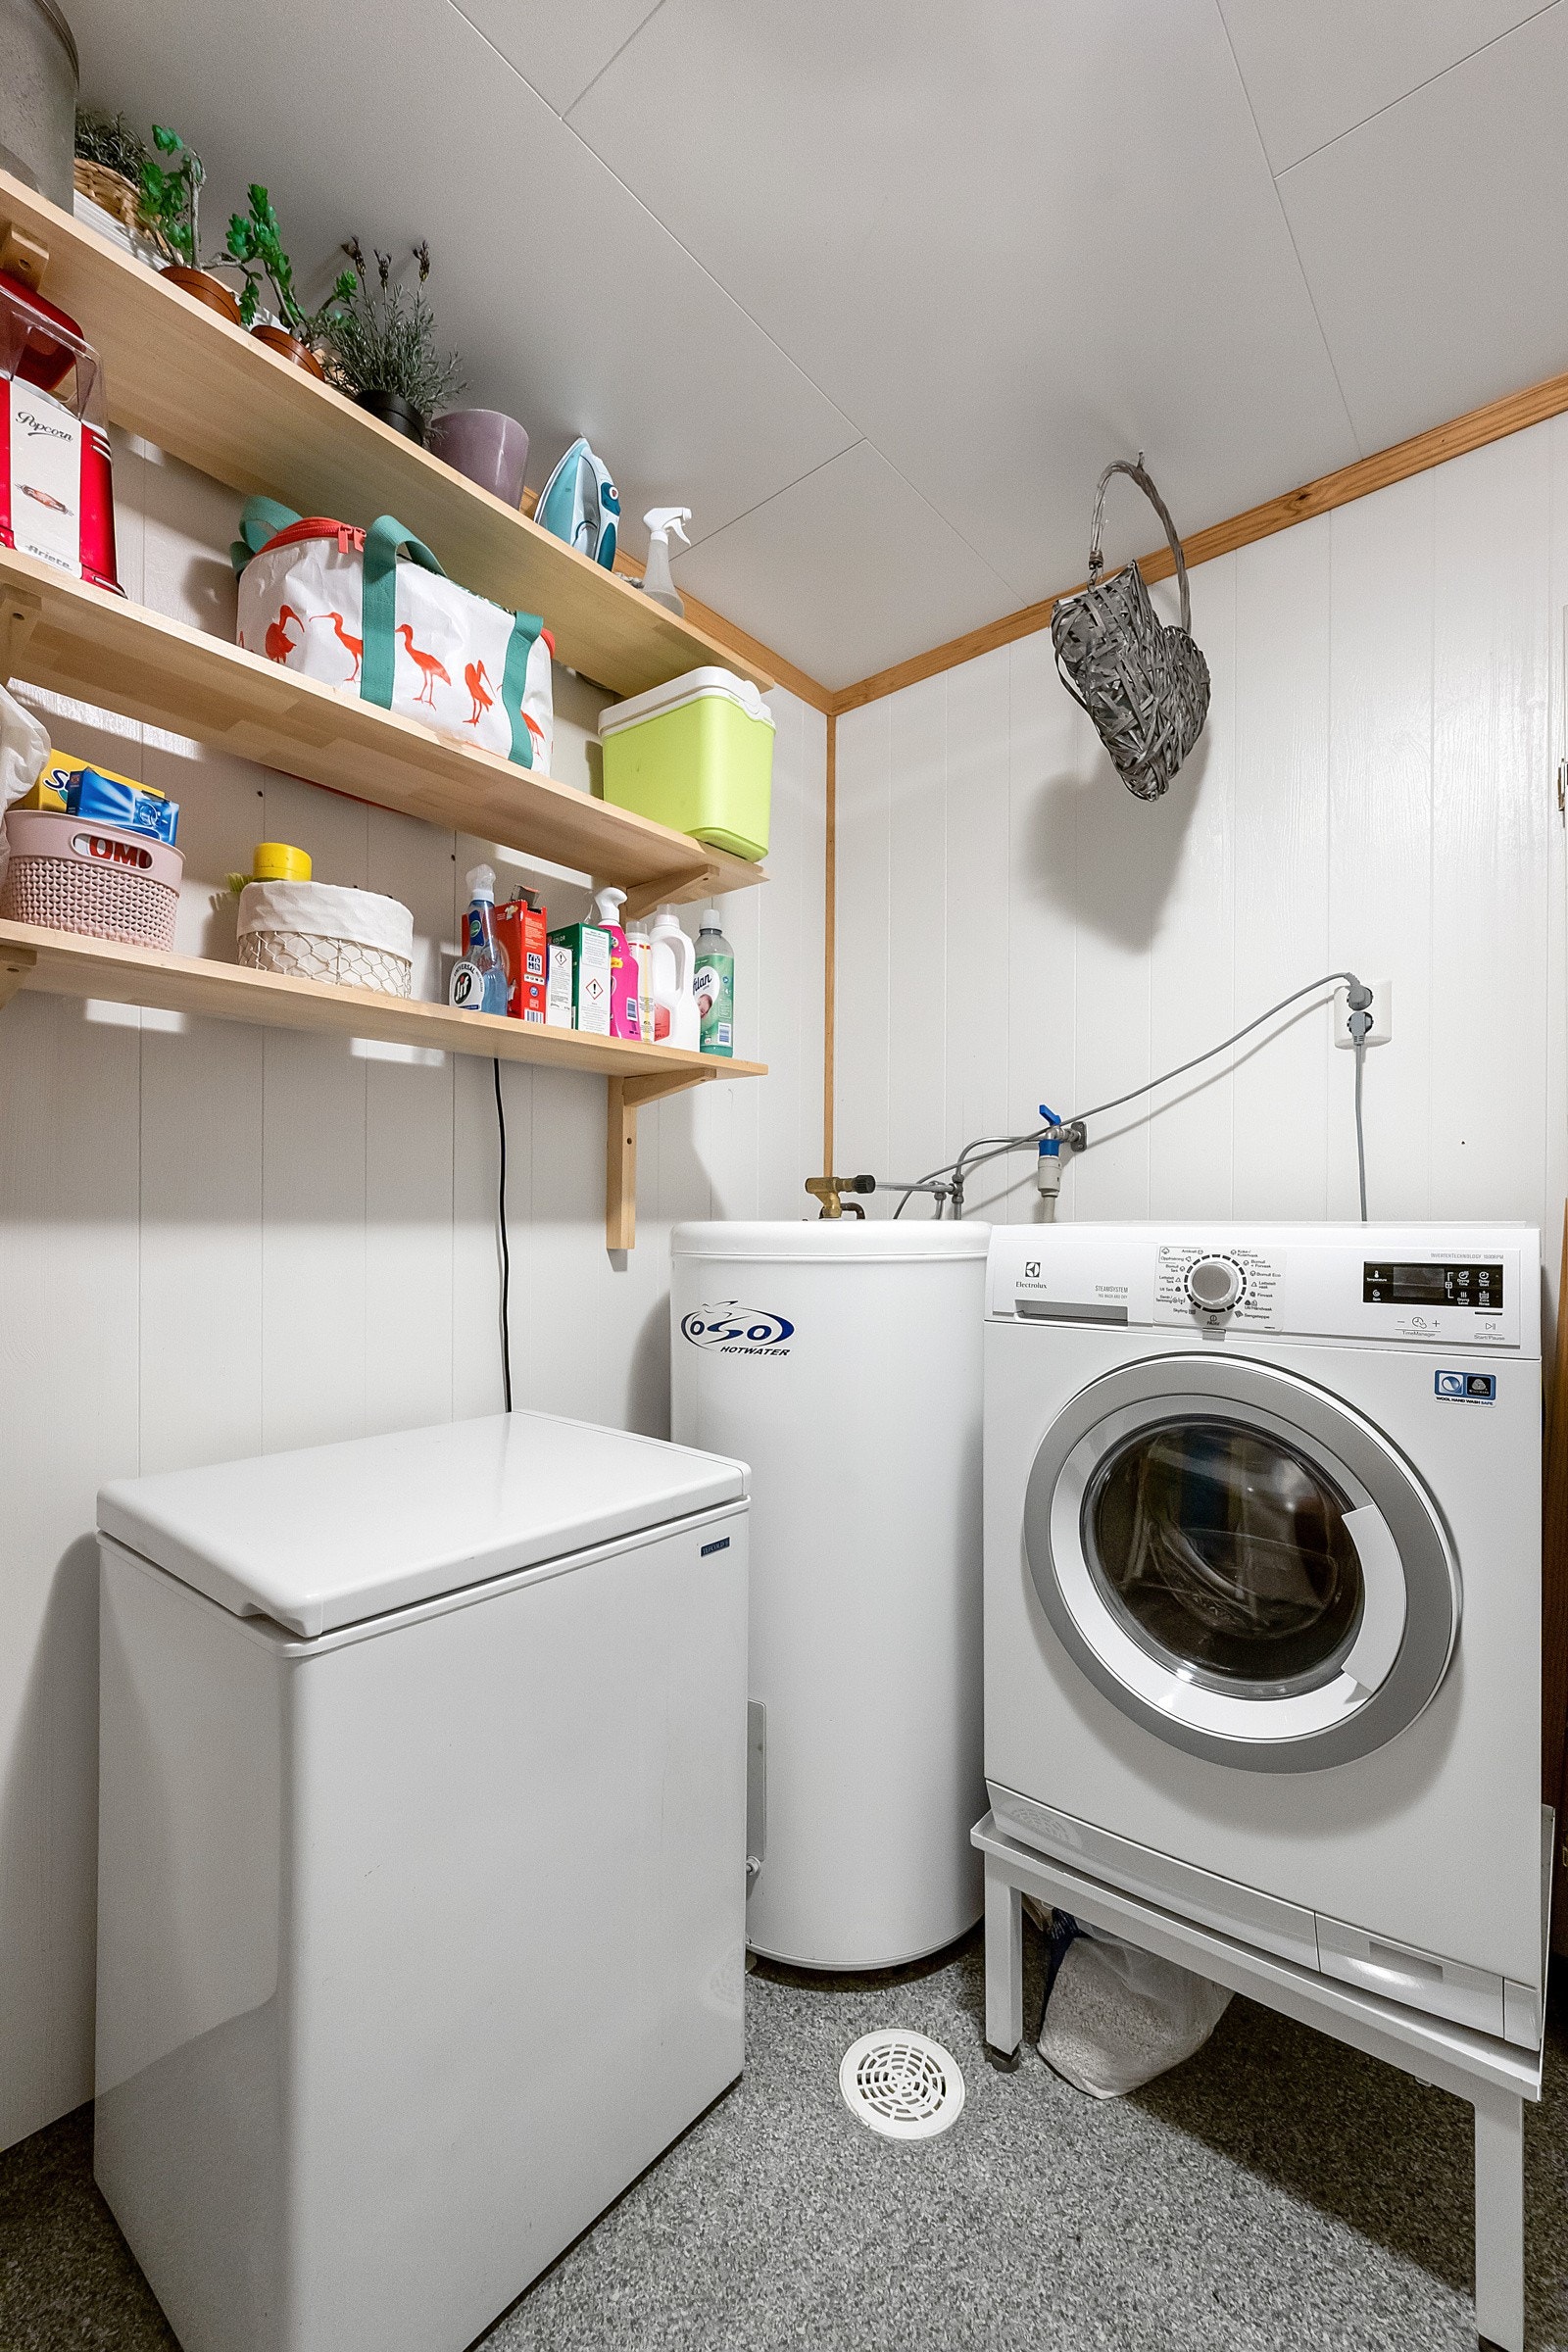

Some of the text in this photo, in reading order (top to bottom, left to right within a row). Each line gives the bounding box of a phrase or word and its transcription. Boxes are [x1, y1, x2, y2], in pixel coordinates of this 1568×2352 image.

[15, 411, 74, 442] Popcorn
[1015, 1281, 1048, 1290] Electrolux
[1095, 1285, 1129, 1294] STEAMSYSTEM
[719, 1346, 791, 1356] HOTWATER
